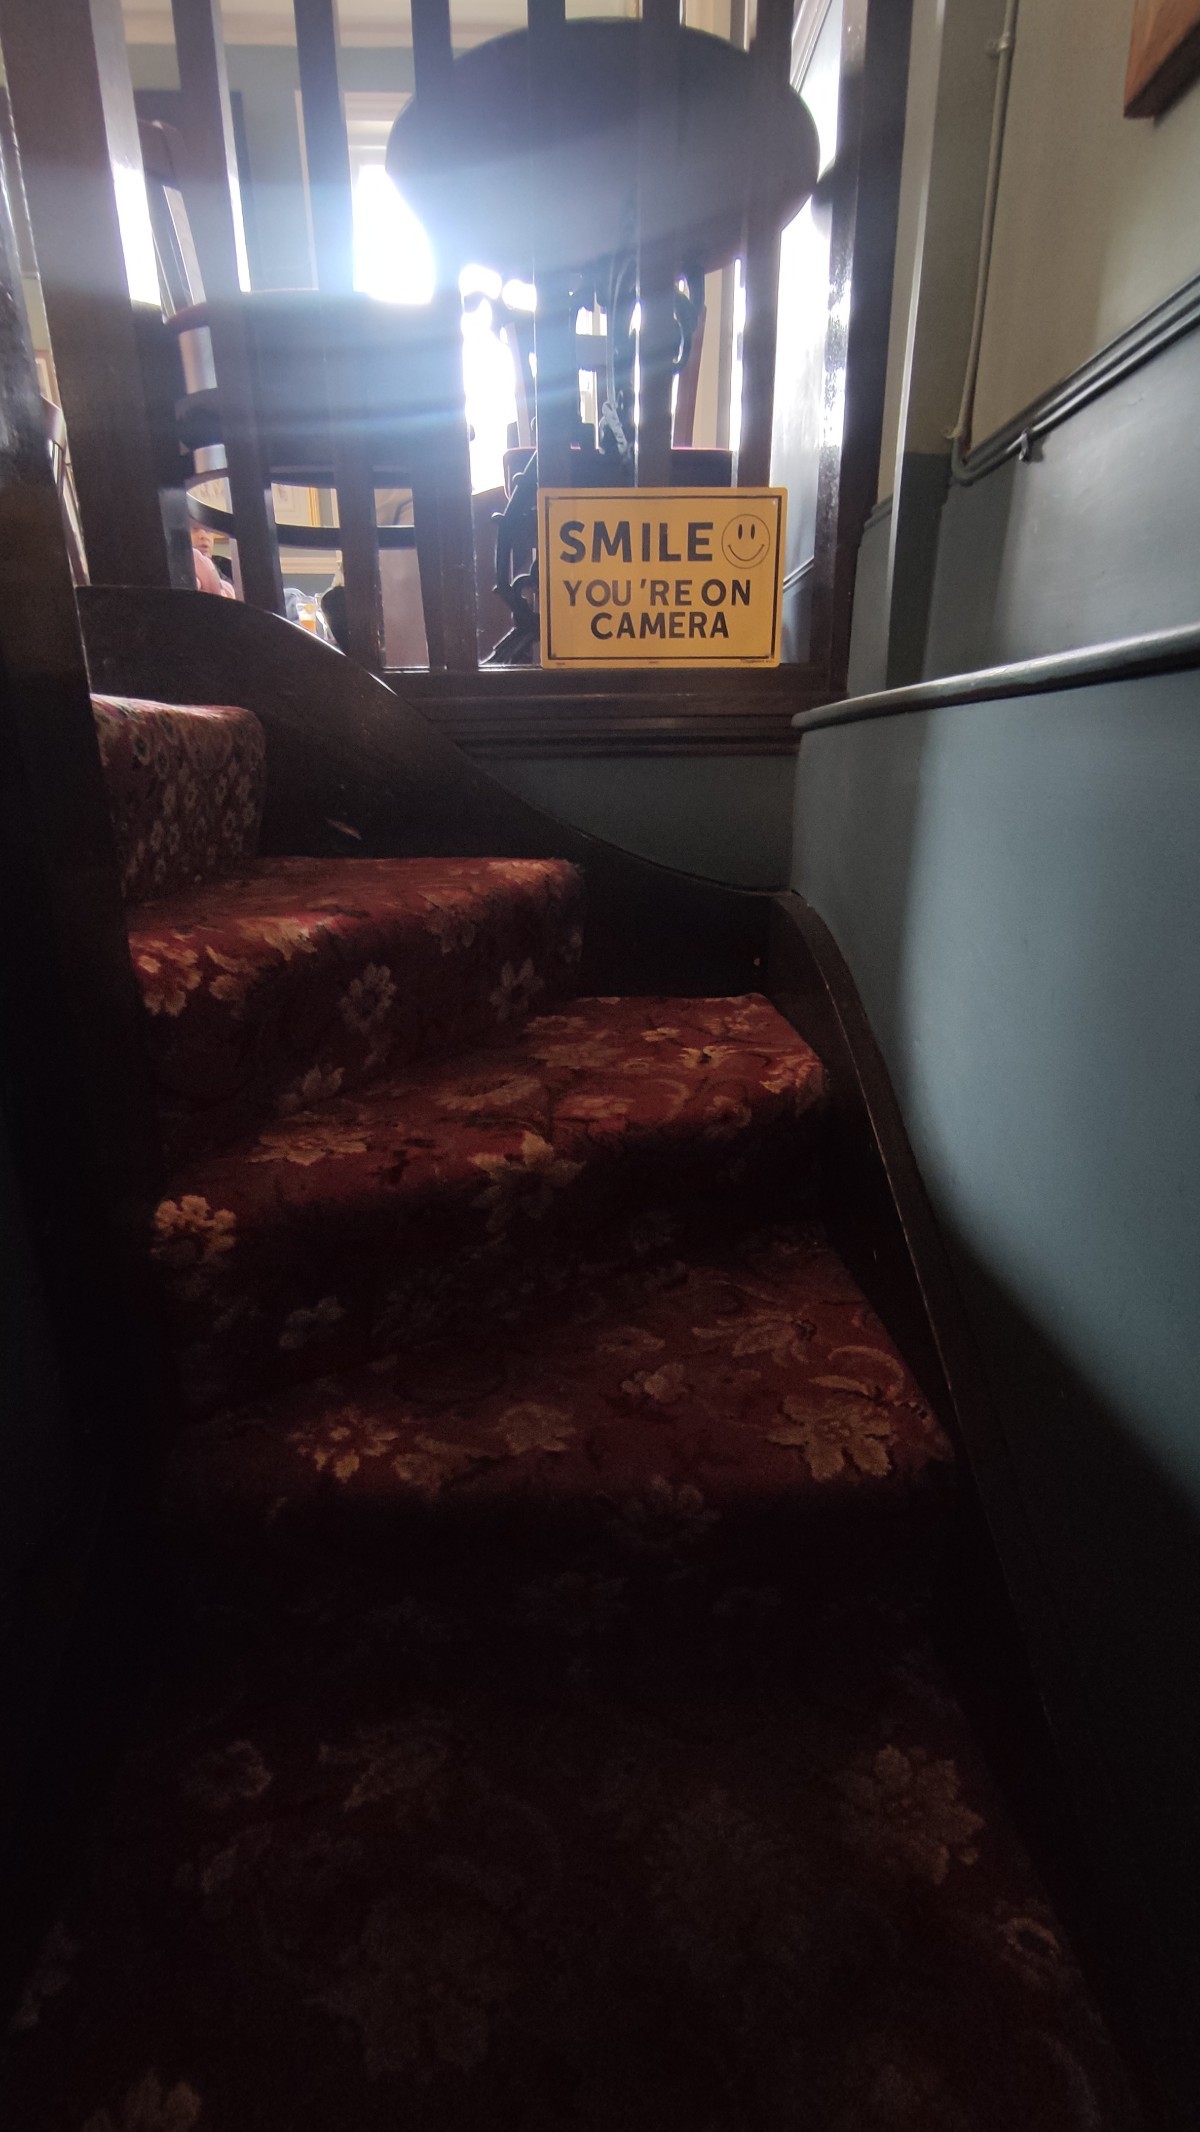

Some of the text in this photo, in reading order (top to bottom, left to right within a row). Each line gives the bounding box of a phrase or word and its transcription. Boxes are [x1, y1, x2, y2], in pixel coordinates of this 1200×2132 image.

[559, 520, 714, 563] SMILE
[563, 578, 751, 607] YOU'RE ON
[590, 611, 730, 640] CAMERA
